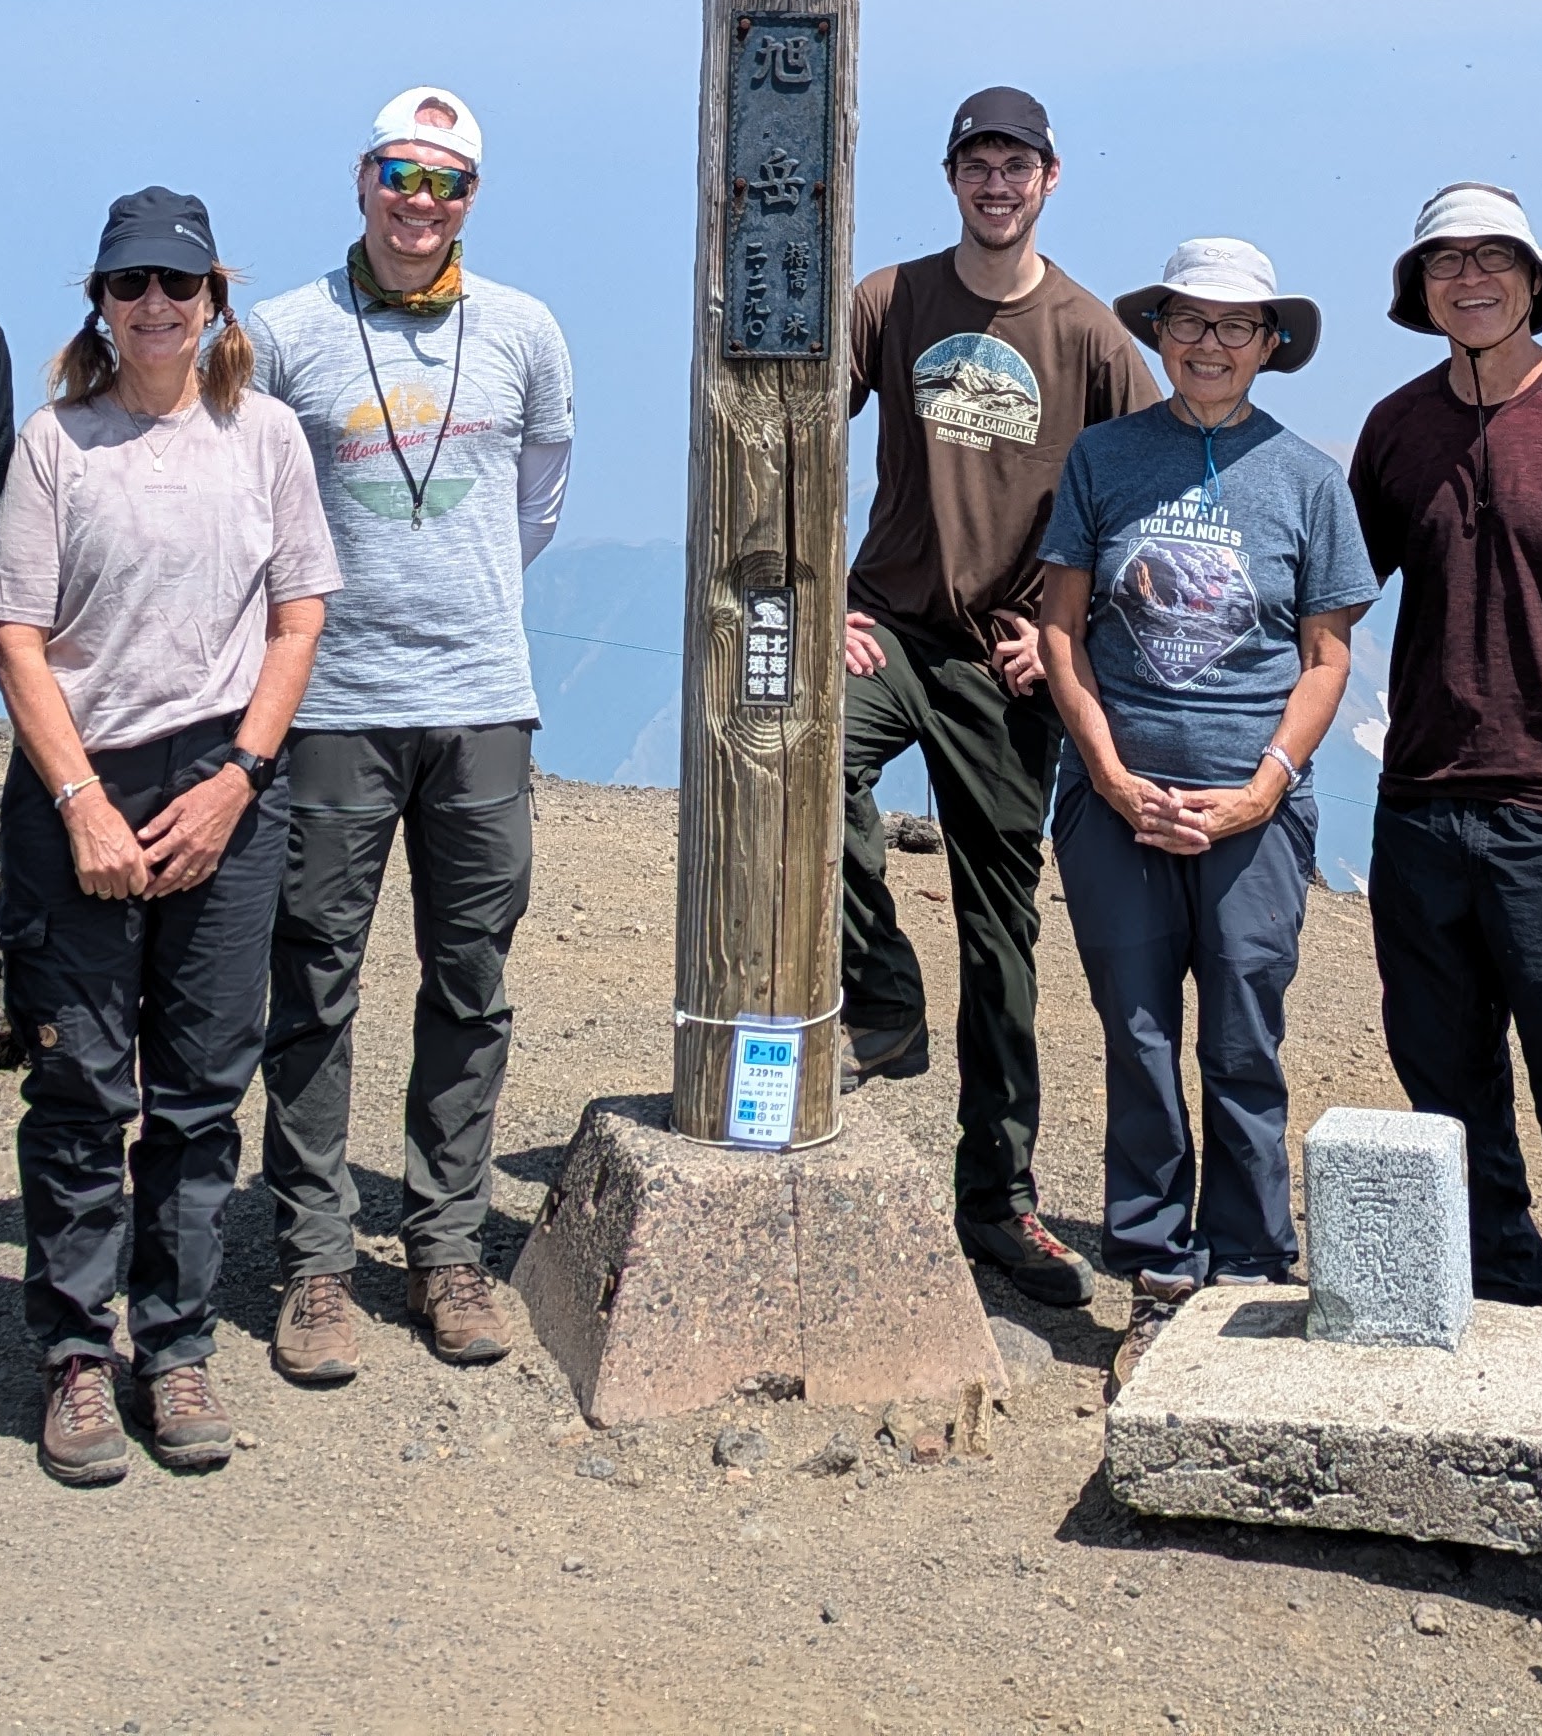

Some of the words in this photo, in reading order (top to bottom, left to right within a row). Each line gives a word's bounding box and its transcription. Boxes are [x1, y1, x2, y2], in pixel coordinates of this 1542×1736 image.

[750, 35, 813, 207] 旭岳
[976, 415, 1038, 442] ASAHIDAKE
[1139, 518, 1242, 547] VOLCANOES
[1153, 639, 1205, 655] NATIONAL
[1163, 650, 1191, 664] PARK
[767, 634, 788, 696] 北海道
[748, 1044, 787, 1062] P-10
[749, 1068, 783, 1078] 2291m
